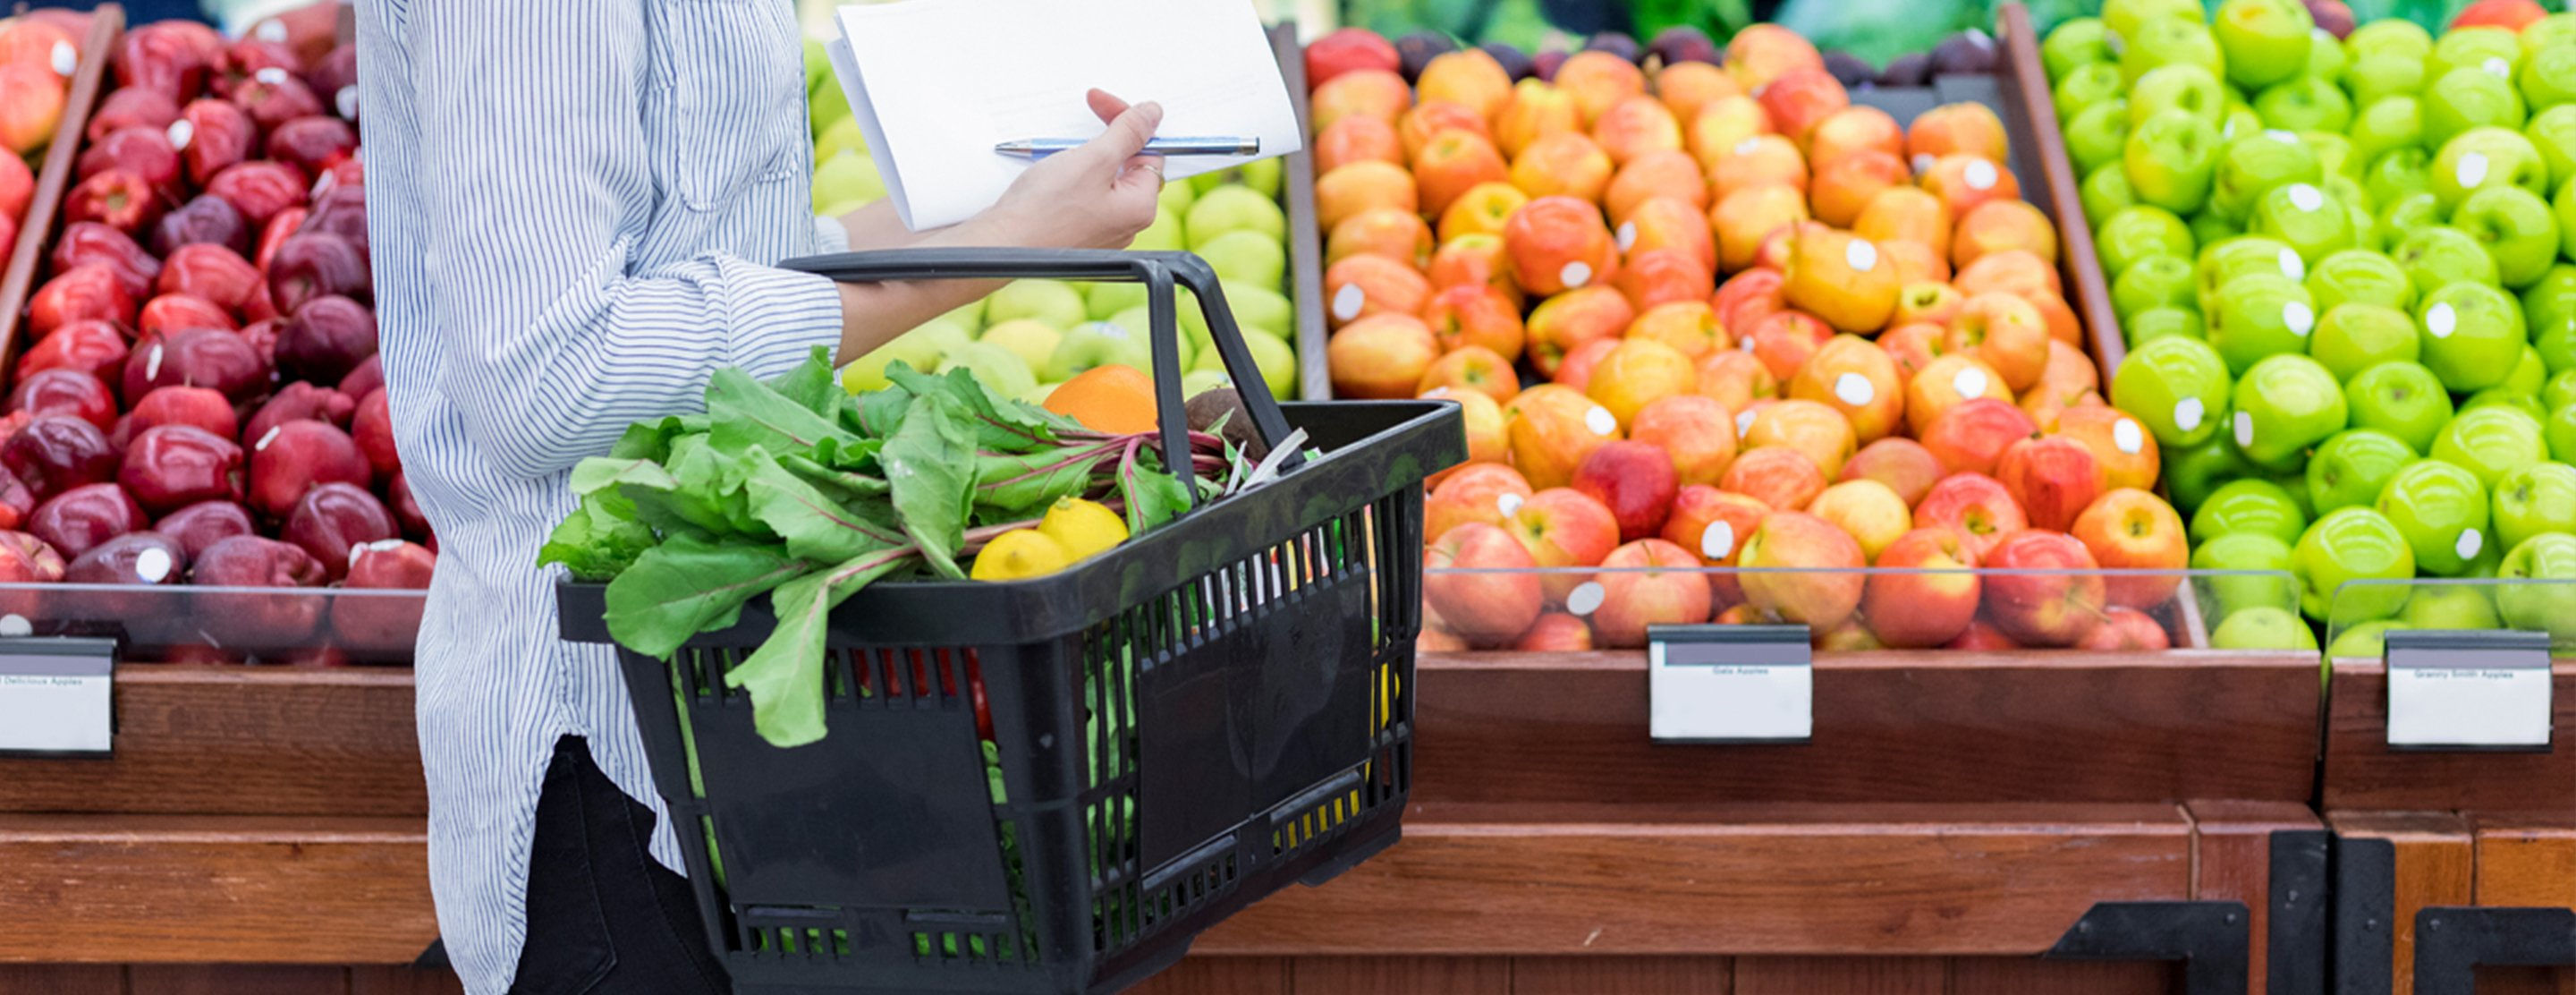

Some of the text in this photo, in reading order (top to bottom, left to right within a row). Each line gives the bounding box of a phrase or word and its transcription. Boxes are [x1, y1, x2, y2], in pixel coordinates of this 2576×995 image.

[1712, 666, 1733, 676] Gala
[2414, 668, 2513, 680] Granny Smith Apples
[51, 676, 82, 686] Apples
